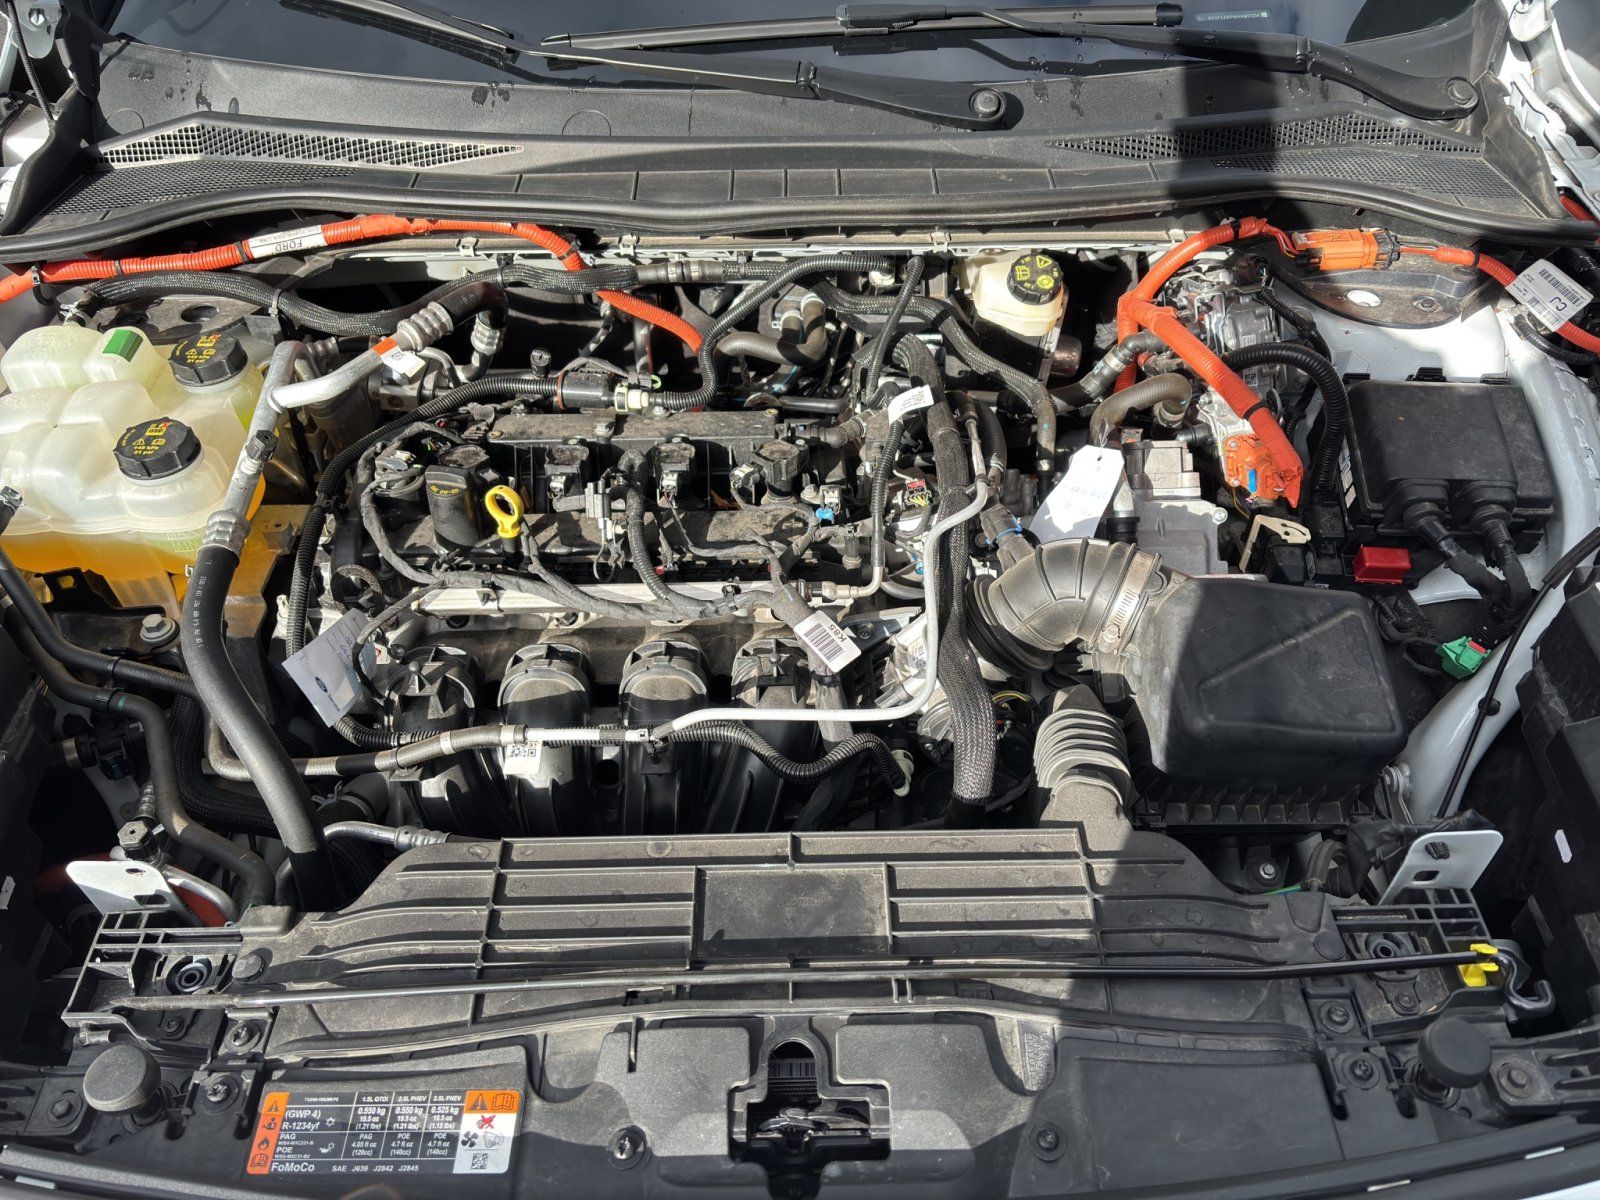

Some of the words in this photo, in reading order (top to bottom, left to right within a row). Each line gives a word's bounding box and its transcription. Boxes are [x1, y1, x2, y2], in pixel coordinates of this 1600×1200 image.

[275, 239, 302, 252] FORD
[1549, 296, 1568, 312] CJ
[828, 624, 847, 642] K85
[328, 694, 340, 712] Service
[285, 1110, 310, 1120] (GWP
[311, 1110, 321, 1120] 4)
[358, 1106, 376, 1114] 0.550
[377, 1106, 386, 1116] kg
[414, 1106, 423, 1115] kg
[431, 1106, 449, 1114] 0.525
[450, 1106, 459, 1115] kg
[282, 1121, 320, 1131] R-1234yf
[427, 1148, 448, 1156] (140cc)
[271, 1162, 315, 1172] FoMoCo
